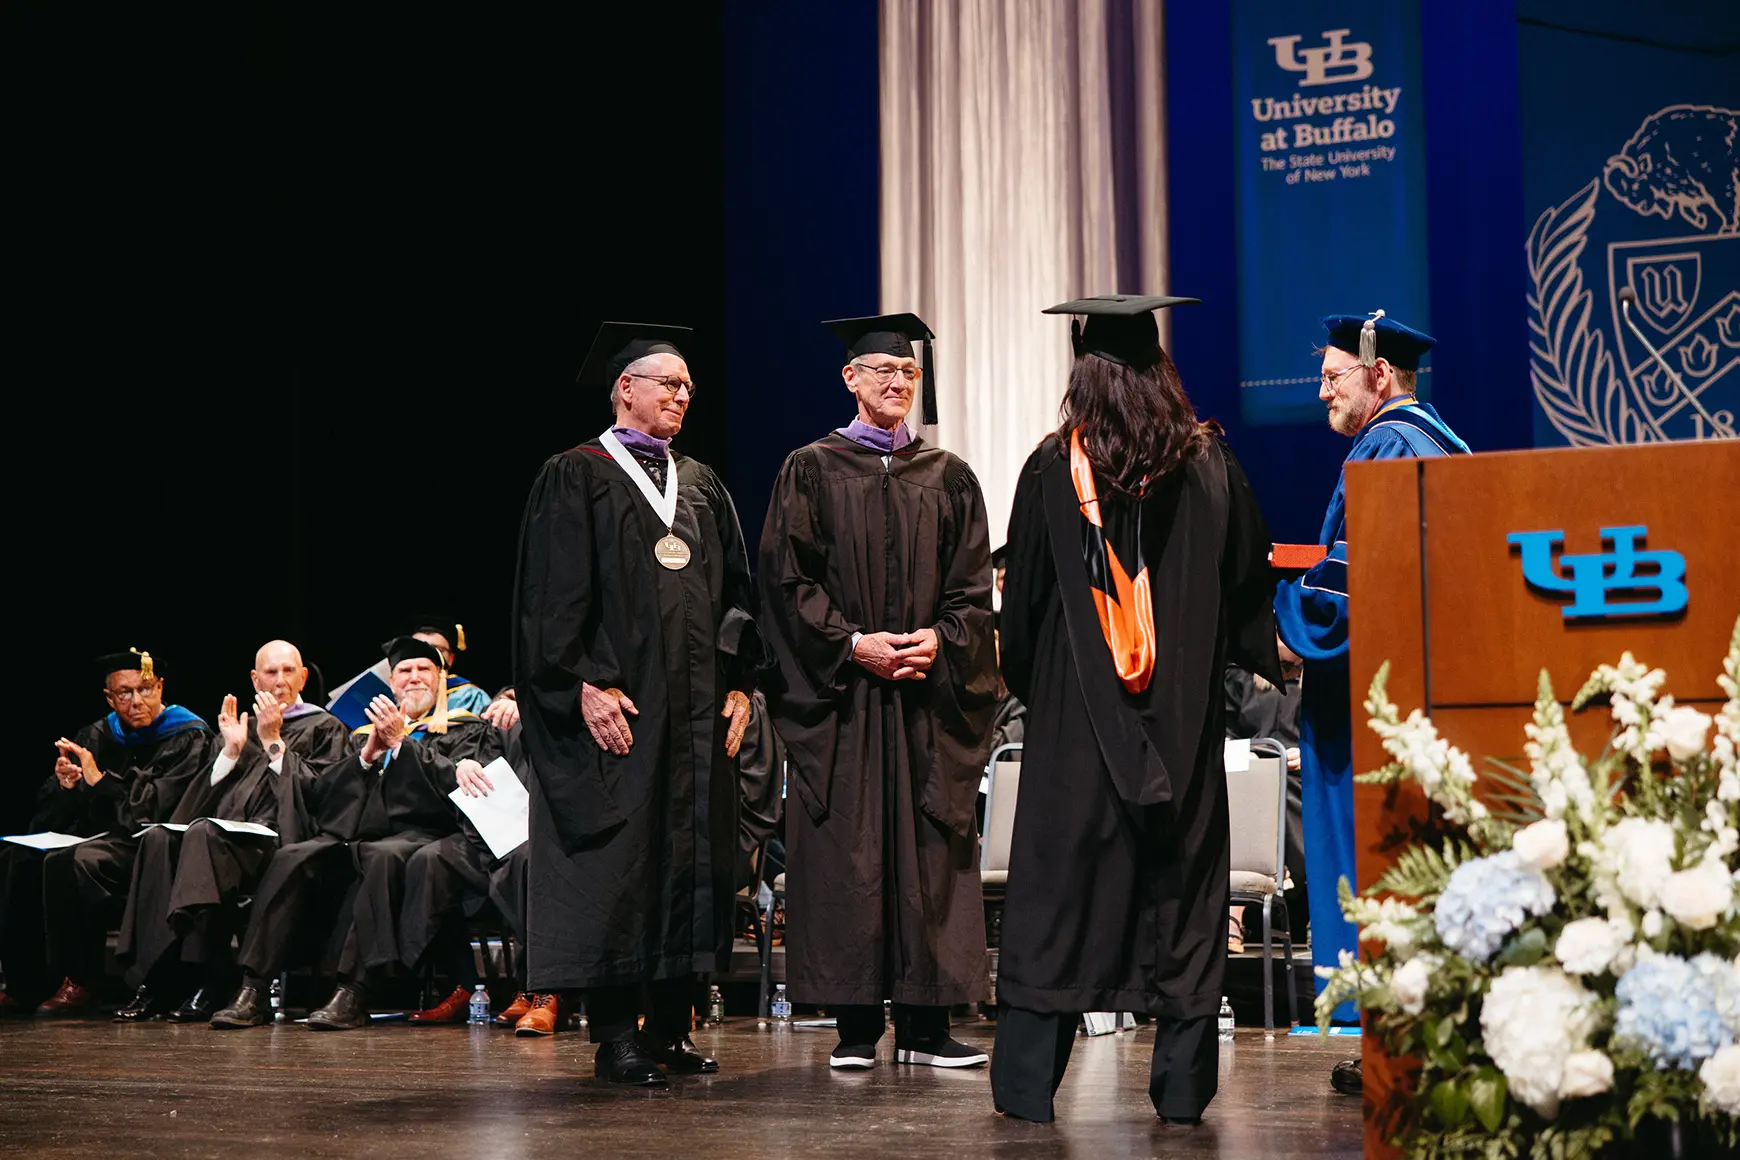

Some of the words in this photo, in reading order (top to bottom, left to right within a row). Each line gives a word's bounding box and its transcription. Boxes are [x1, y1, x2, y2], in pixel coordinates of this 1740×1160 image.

[1267, 28, 1373, 86] UB
[1251, 85, 1401, 121] University
[1260, 128, 1288, 151] at
[1293, 114, 1395, 147] Buffalo
[1261, 157, 1286, 171] The
[1289, 154, 1325, 168] State
[1328, 146, 1396, 163] University
[1286, 170, 1302, 184] of
[1304, 168, 1336, 182] New
[1339, 163, 1370, 178] York
[1506, 525, 1689, 617] UB
